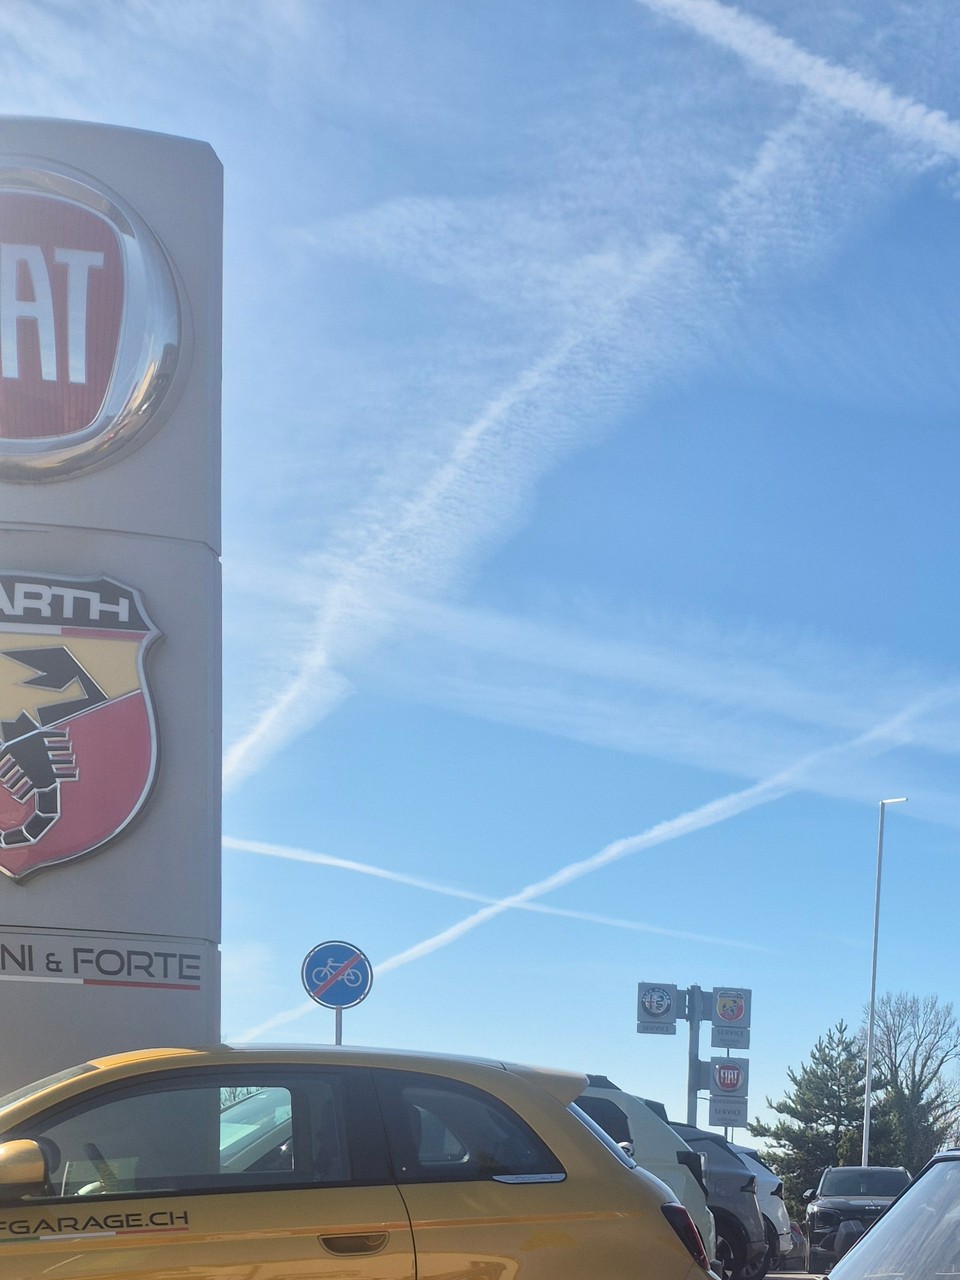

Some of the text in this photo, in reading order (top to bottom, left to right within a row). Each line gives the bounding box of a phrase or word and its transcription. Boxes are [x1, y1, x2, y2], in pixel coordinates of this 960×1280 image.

[45, 952, 63, 972] &
[73, 947, 201, 980] FORTE
[641, 1024, 669, 1033] SERVICE
[717, 1028, 745, 1036] SERVICE
[720, 1069, 739, 1084] FIAT
[714, 1108, 741, 1116] SERVICE
